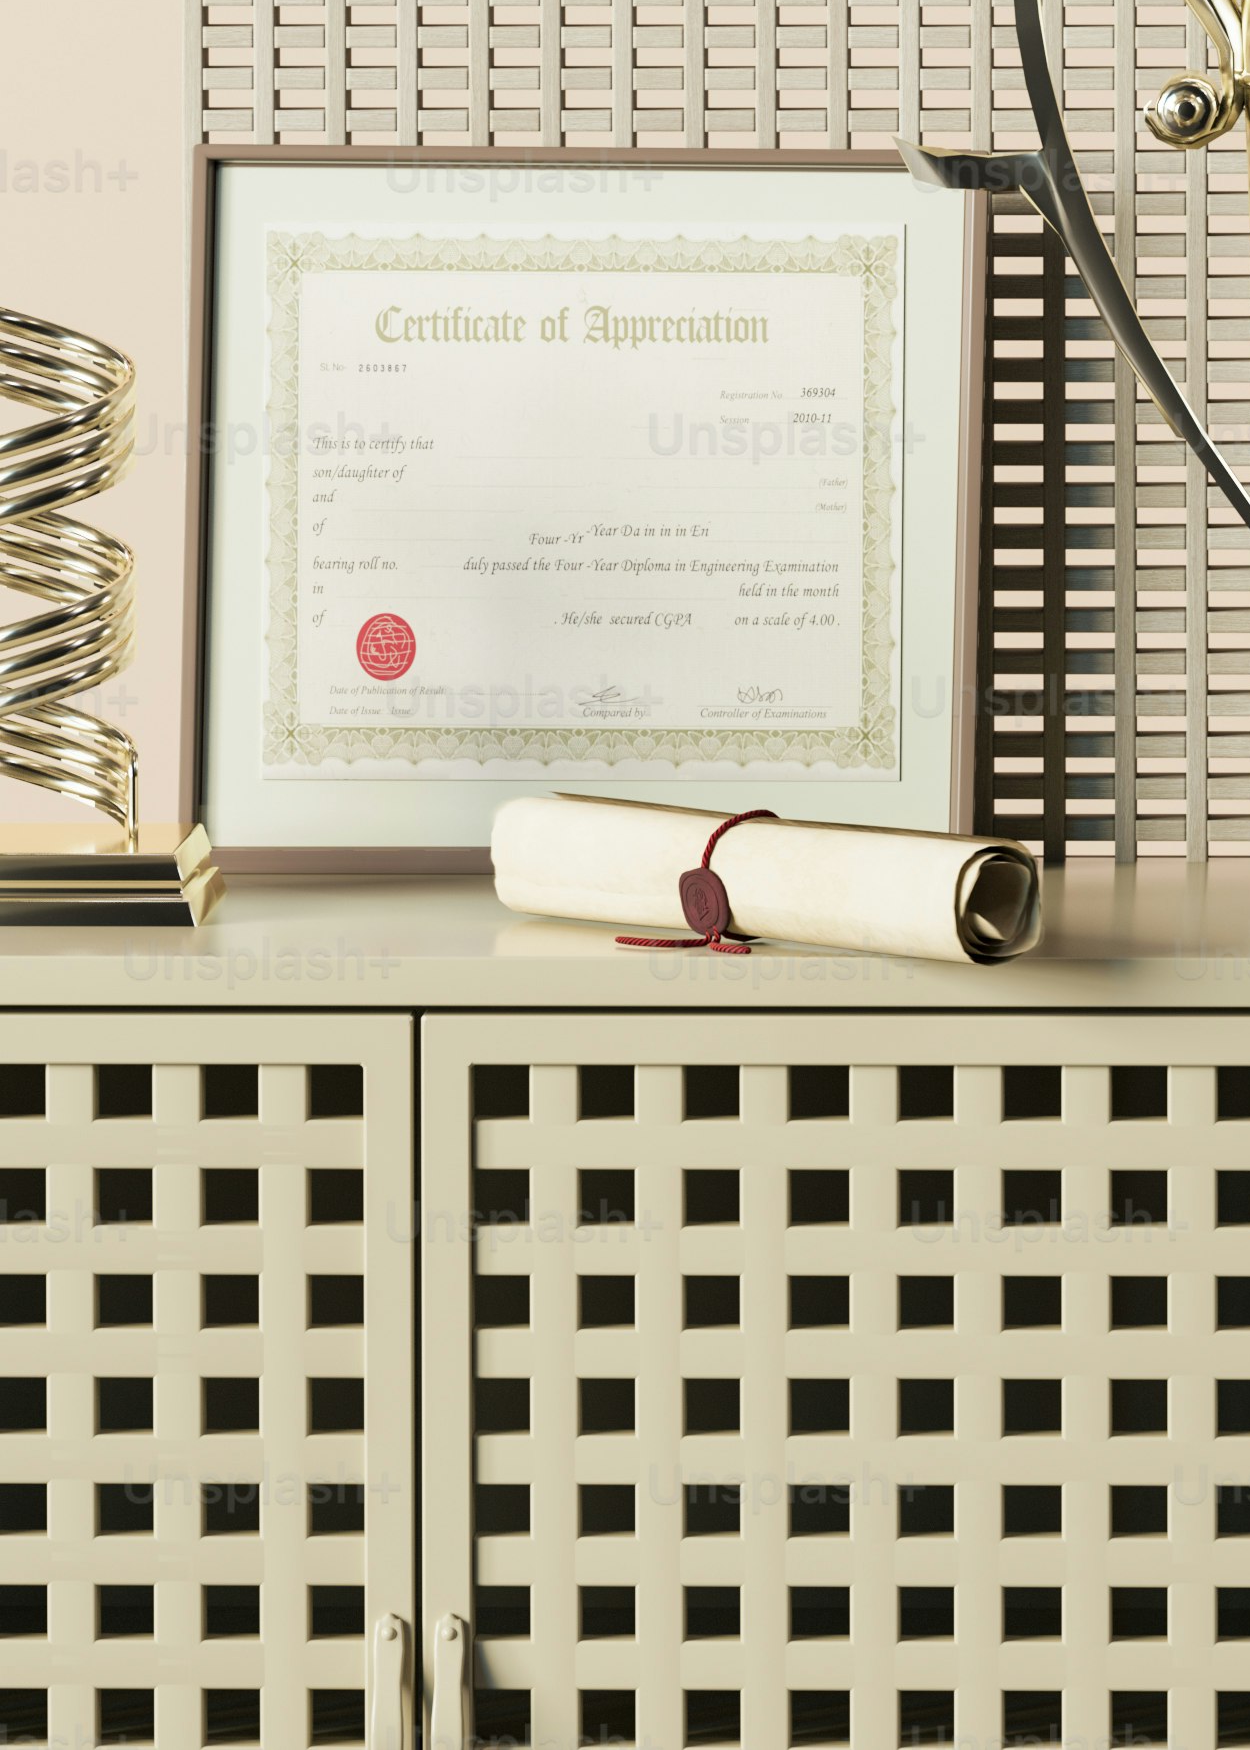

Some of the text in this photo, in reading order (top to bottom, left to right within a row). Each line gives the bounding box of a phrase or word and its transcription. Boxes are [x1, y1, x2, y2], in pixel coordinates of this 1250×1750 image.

[375, 305, 770, 350] Certificate of Appreciation
[720, 389, 769, 402] Registration
[800, 386, 837, 399] 369304
[719, 411, 833, 426] Session 2010-11
[312, 435, 435, 454] This is to certify that
[312, 464, 408, 483] son/daughter of
[818, 477, 849, 490] (Father)
[312, 489, 338, 503] and
[814, 502, 848, 514] (Mother)
[312, 517, 328, 537] of
[620, 524, 641, 537] Da
[644, 524, 656, 537] in
[660, 524, 672, 537] in
[675, 524, 687, 537] in
[312, 555, 355, 575] bearing
[358, 556, 379, 571] roll
[463, 556, 489, 575] duly
[491, 556, 533, 575] passed
[533, 556, 551, 571] the
[555, 558, 585, 571] Four
[620, 558, 671, 576] Diploma
[674, 559, 687, 572] in
[690, 559, 761, 576] Engineering
[763, 559, 839, 576] Examination
[312, 581, 324, 595] in
[738, 582, 840, 598] held in the month
[312, 609, 328, 628] of
[609, 611, 653, 626] secured
[654, 611, 693, 630] CGPA
[734, 615, 749, 627] on
[752, 616, 760, 627] a
[762, 611, 791, 627] scale
[793, 611, 808, 631] of
[329, 685, 348, 695] Date
[350, 685, 359, 697] of
[360, 685, 407, 696] Publication
[408, 685, 418, 697] of
[329, 705, 348, 716] Date
[350, 705, 359, 717] of
[582, 707, 647, 720] Compared by
[700, 707, 827, 721] Controller of Examinations
